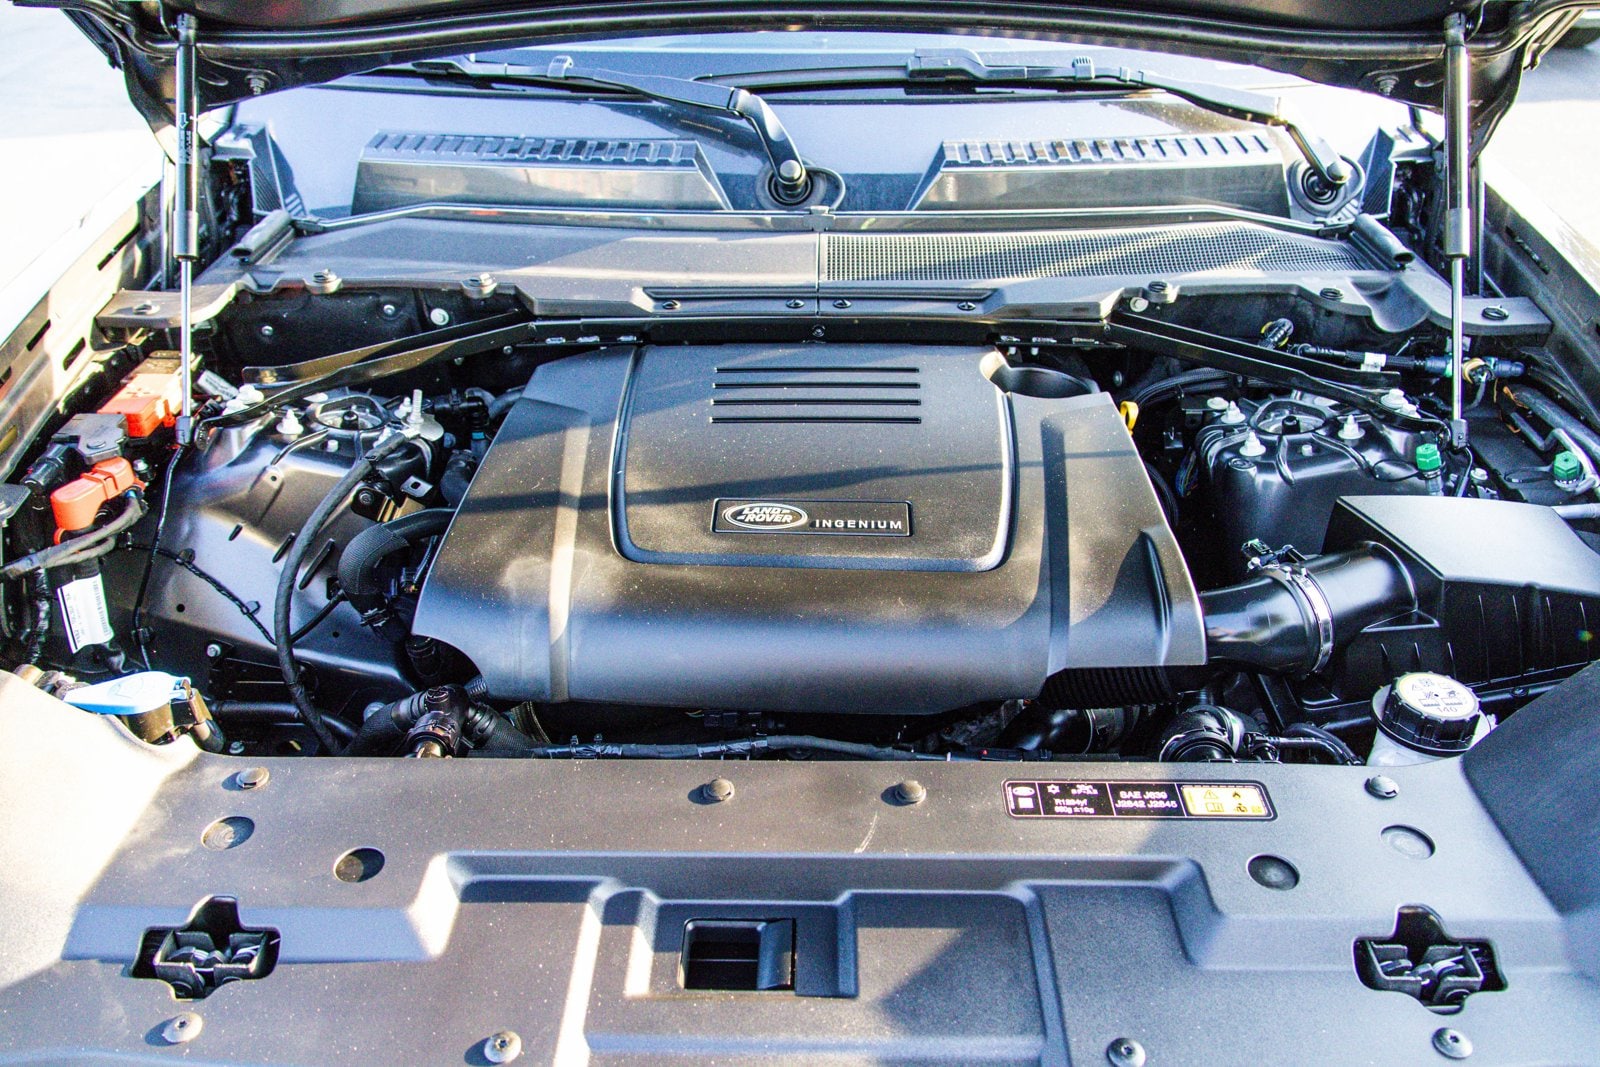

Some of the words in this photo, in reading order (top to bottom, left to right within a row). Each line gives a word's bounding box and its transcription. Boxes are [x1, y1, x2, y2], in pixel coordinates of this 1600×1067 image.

[745, 513, 793, 523] ROVER
[815, 519, 902, 529] INGENIUM
[1119, 790, 1142, 799] SAE
